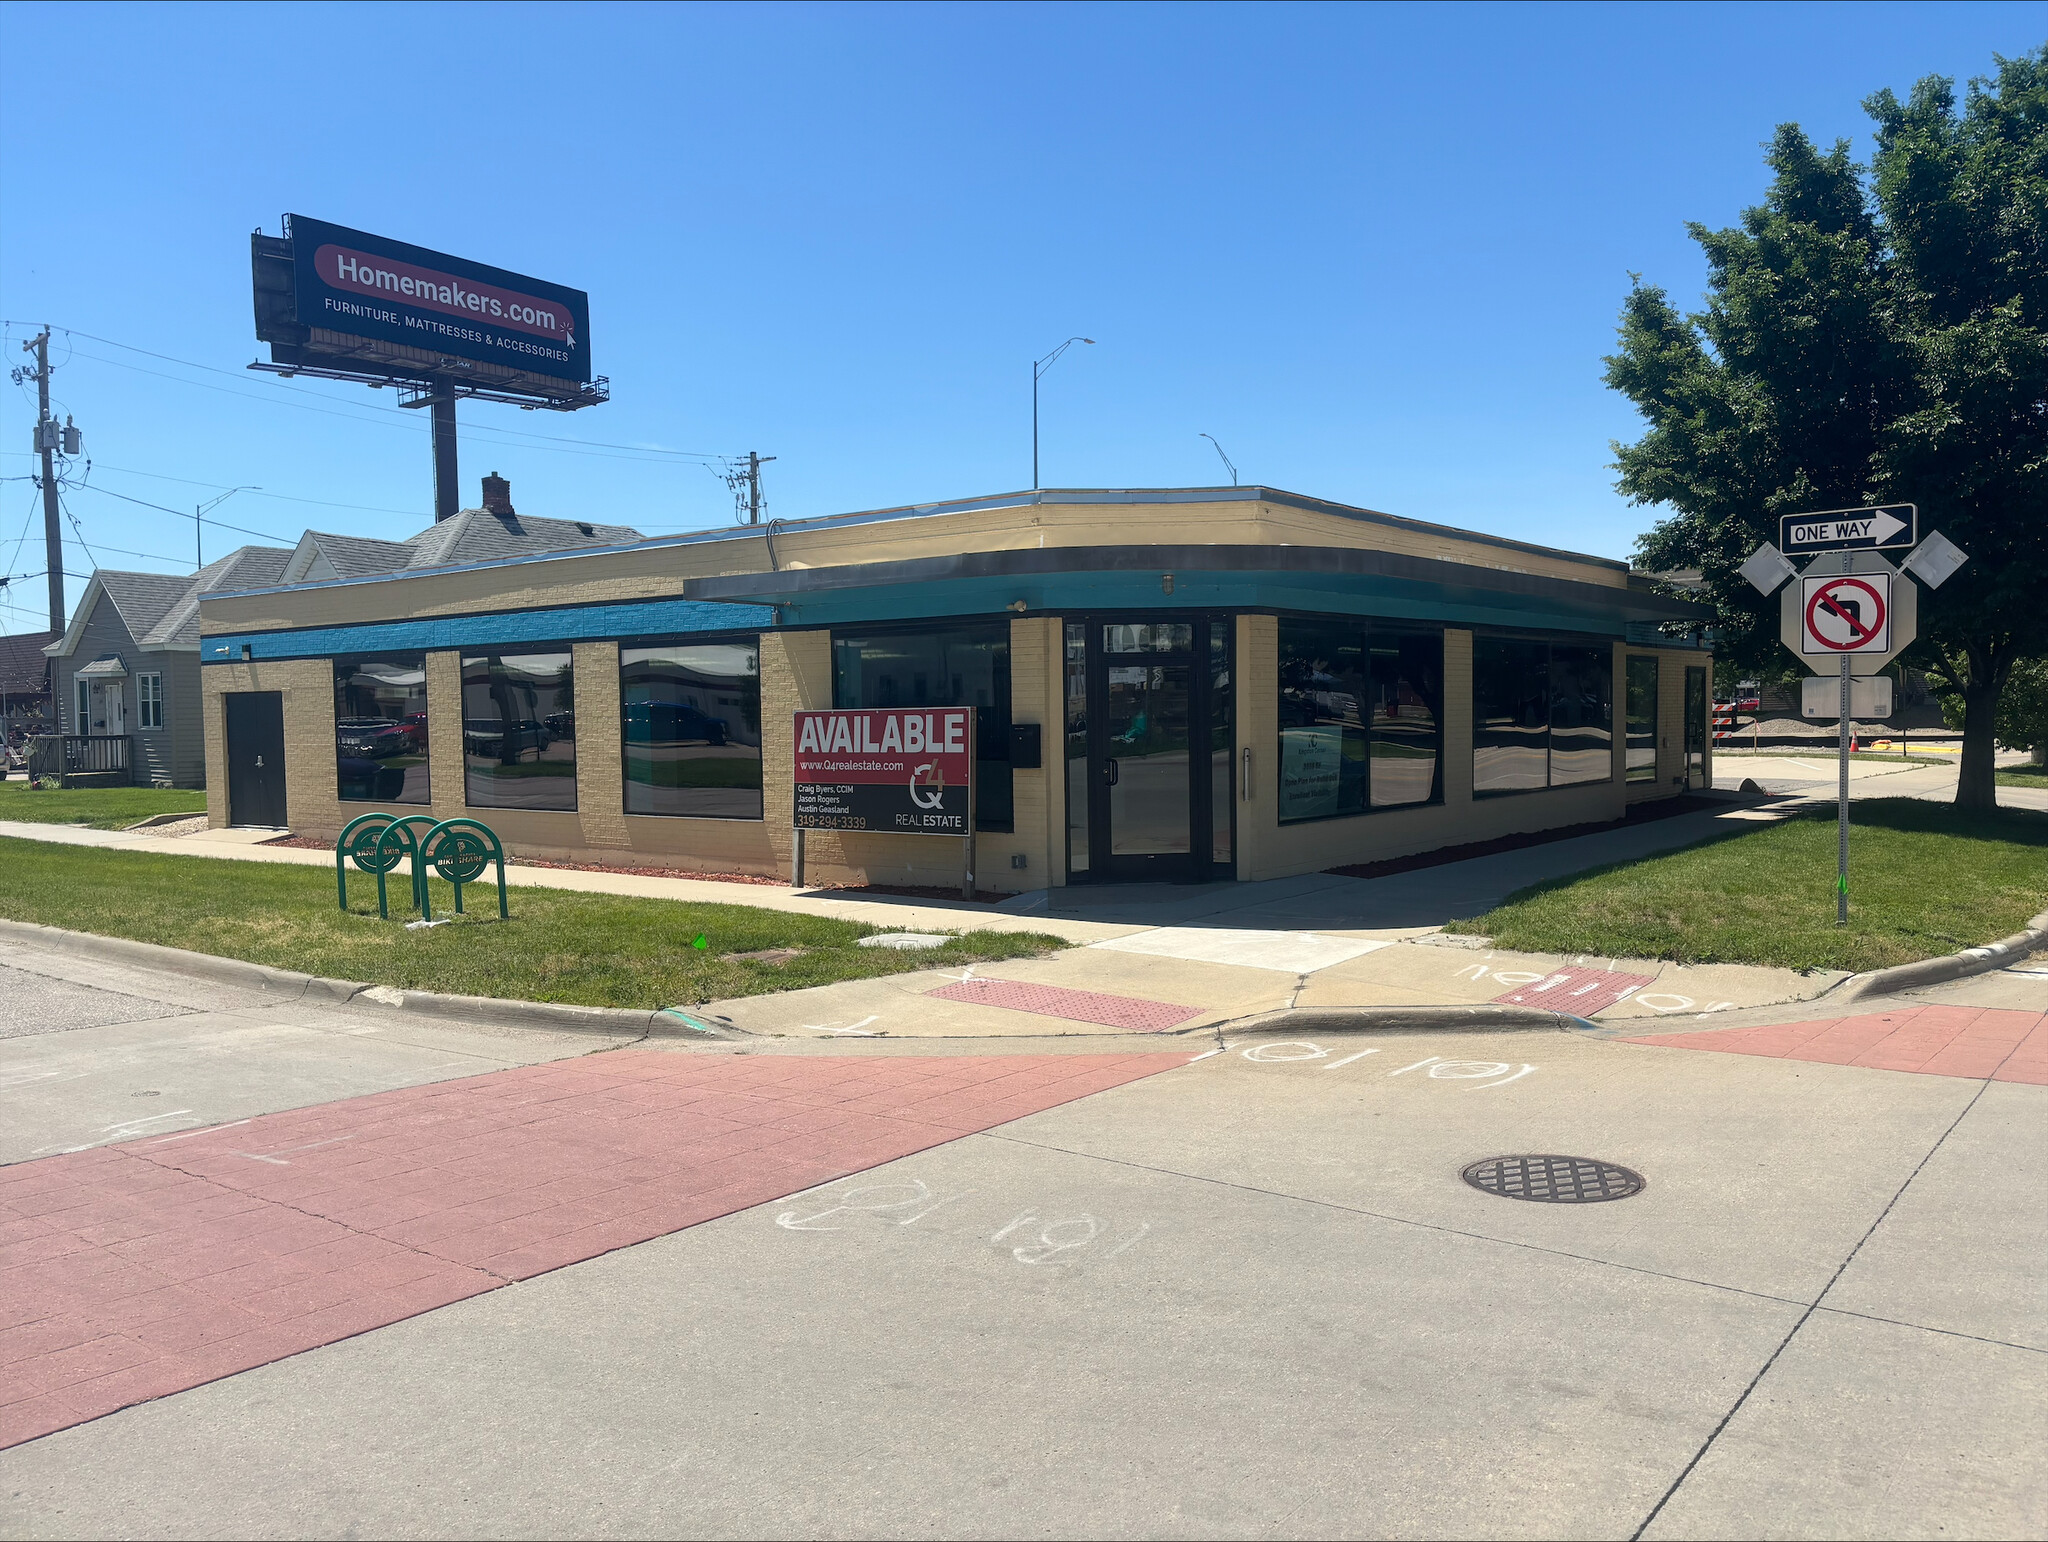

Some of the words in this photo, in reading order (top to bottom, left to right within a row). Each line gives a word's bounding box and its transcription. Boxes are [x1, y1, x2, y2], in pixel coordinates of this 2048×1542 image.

[337, 254, 556, 330] Homemakers.com
[325, 298, 401, 326] FURNITURE,
[405, 315, 482, 343] MATTRESSES
[485, 334, 493, 345] &
[496, 337, 569, 362] ACCESSORIES
[1794, 525, 1829, 542] ONE
[1836, 520, 1872, 538] WAY
[798, 714, 965, 753] AVAILABLE
[800, 759, 904, 771] www.Q4realestate.com
[798, 784, 815, 795] Craig
[816, 785, 836, 795] Byers,
[836, 785, 854, 794] CCIM
[798, 795, 816, 803] Jason
[817, 795, 840, 804] Rogers
[798, 805, 818, 813] Austin
[818, 805, 850, 814] Geasland
[798, 814, 866, 829] 319-294-3339
[896, 814, 922, 826] REAL
[923, 815, 962, 827] ESTATE
